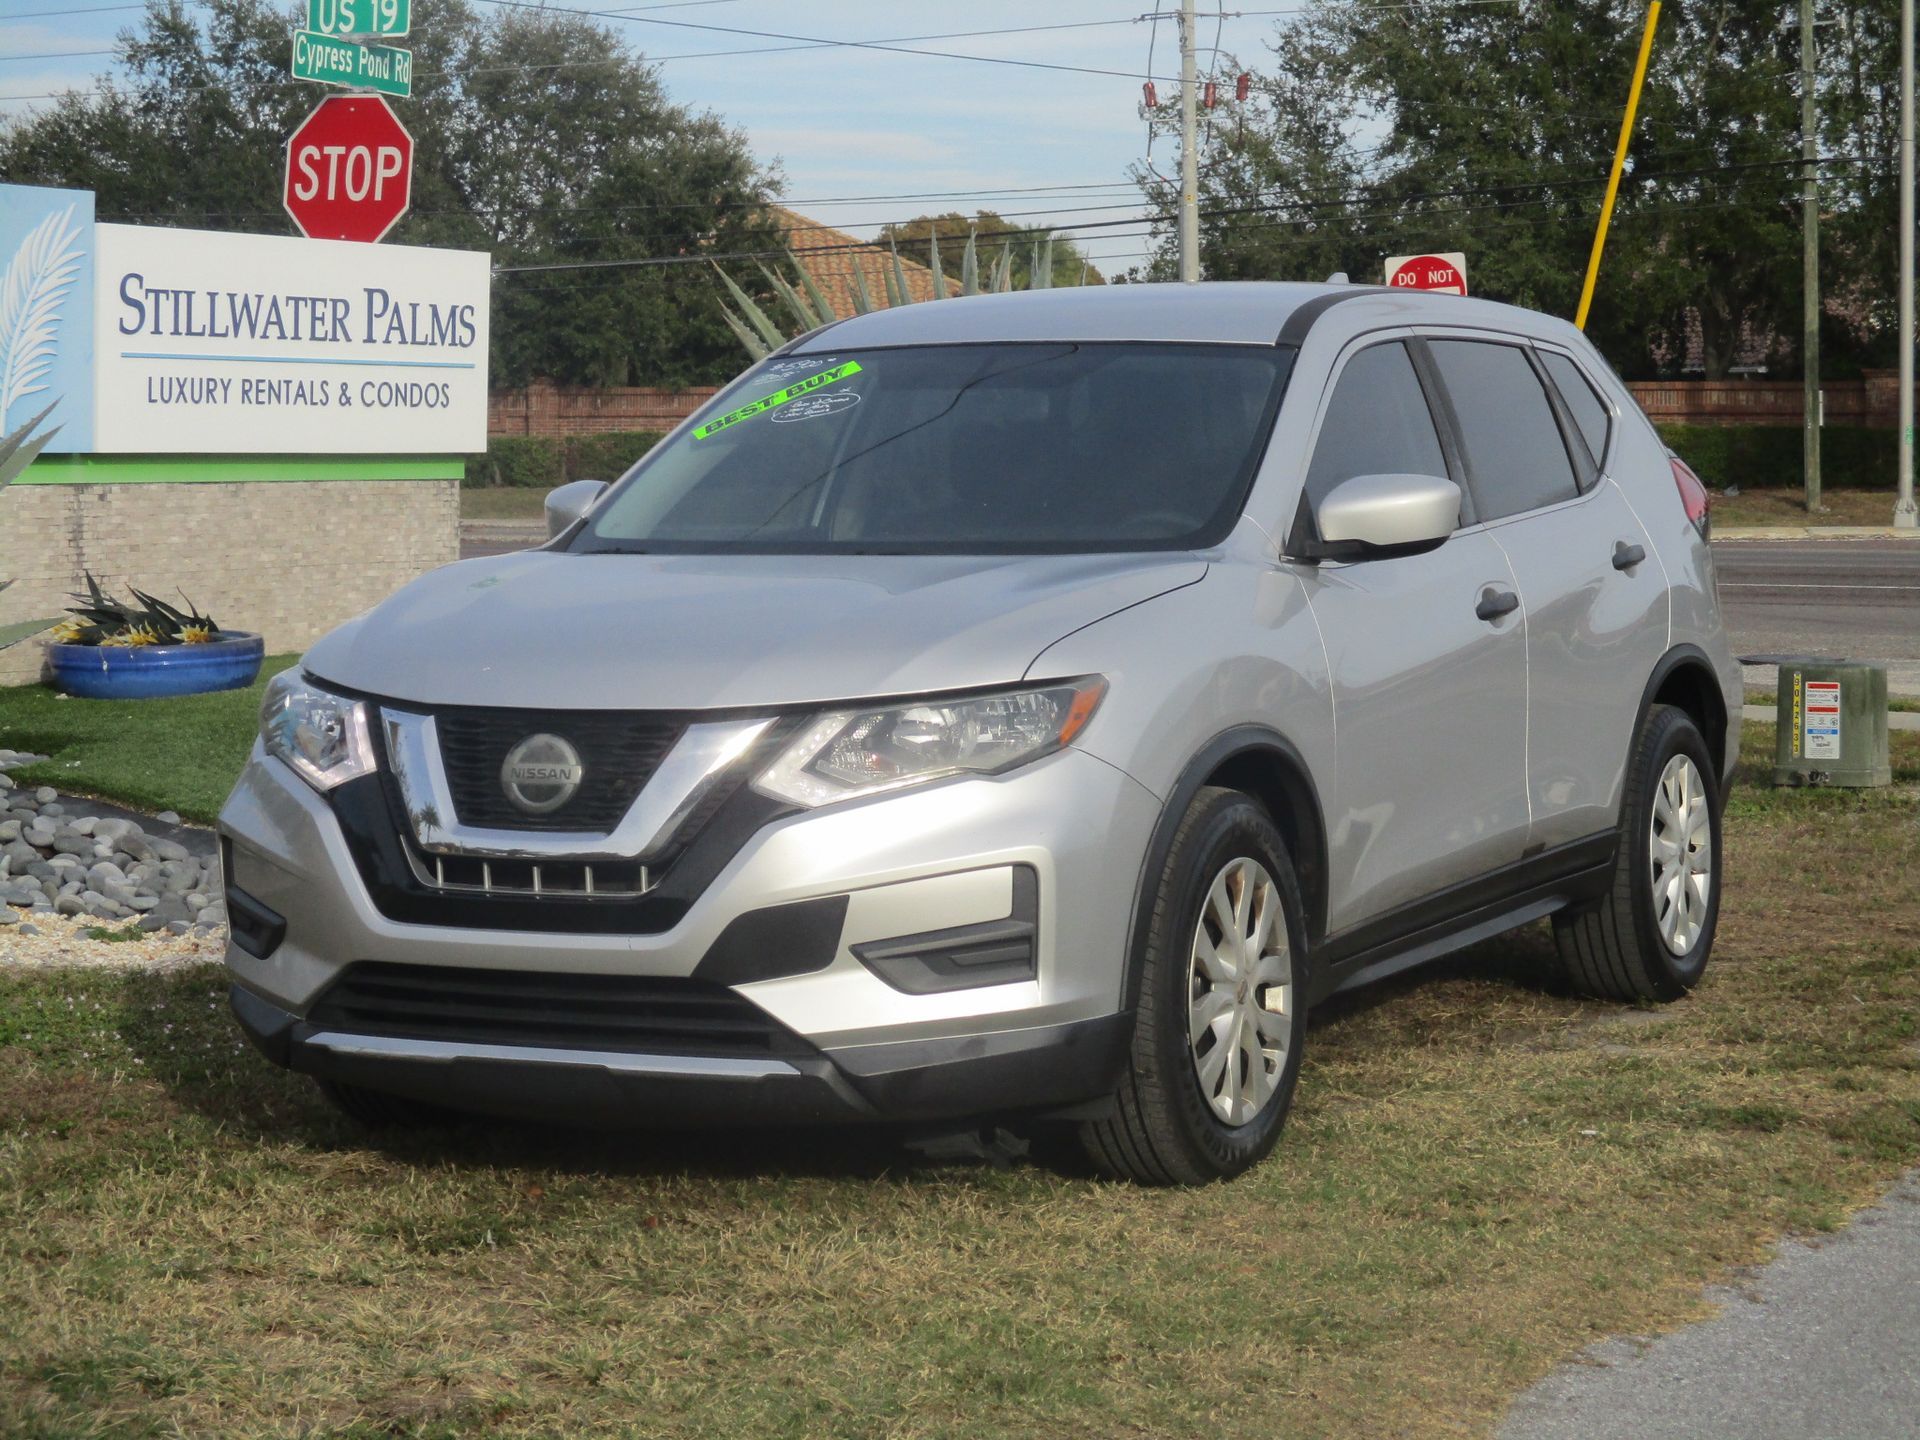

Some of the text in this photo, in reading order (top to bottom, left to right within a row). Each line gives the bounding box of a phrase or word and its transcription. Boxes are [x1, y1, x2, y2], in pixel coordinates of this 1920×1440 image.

[319, 0, 398, 34] US 19
[296, 34, 409, 84] Cypress Pond Rd
[294, 145, 402, 202] STOP
[1398, 269, 1454, 286] DO NOT
[118, 272, 476, 348] STILLWATER PALMS
[147, 376, 450, 408] LUXURY RENTALS & CONDOS
[705, 395, 778, 435] BEST
[786, 367, 846, 399] BUY
[510, 767, 572, 780] NISSAN
